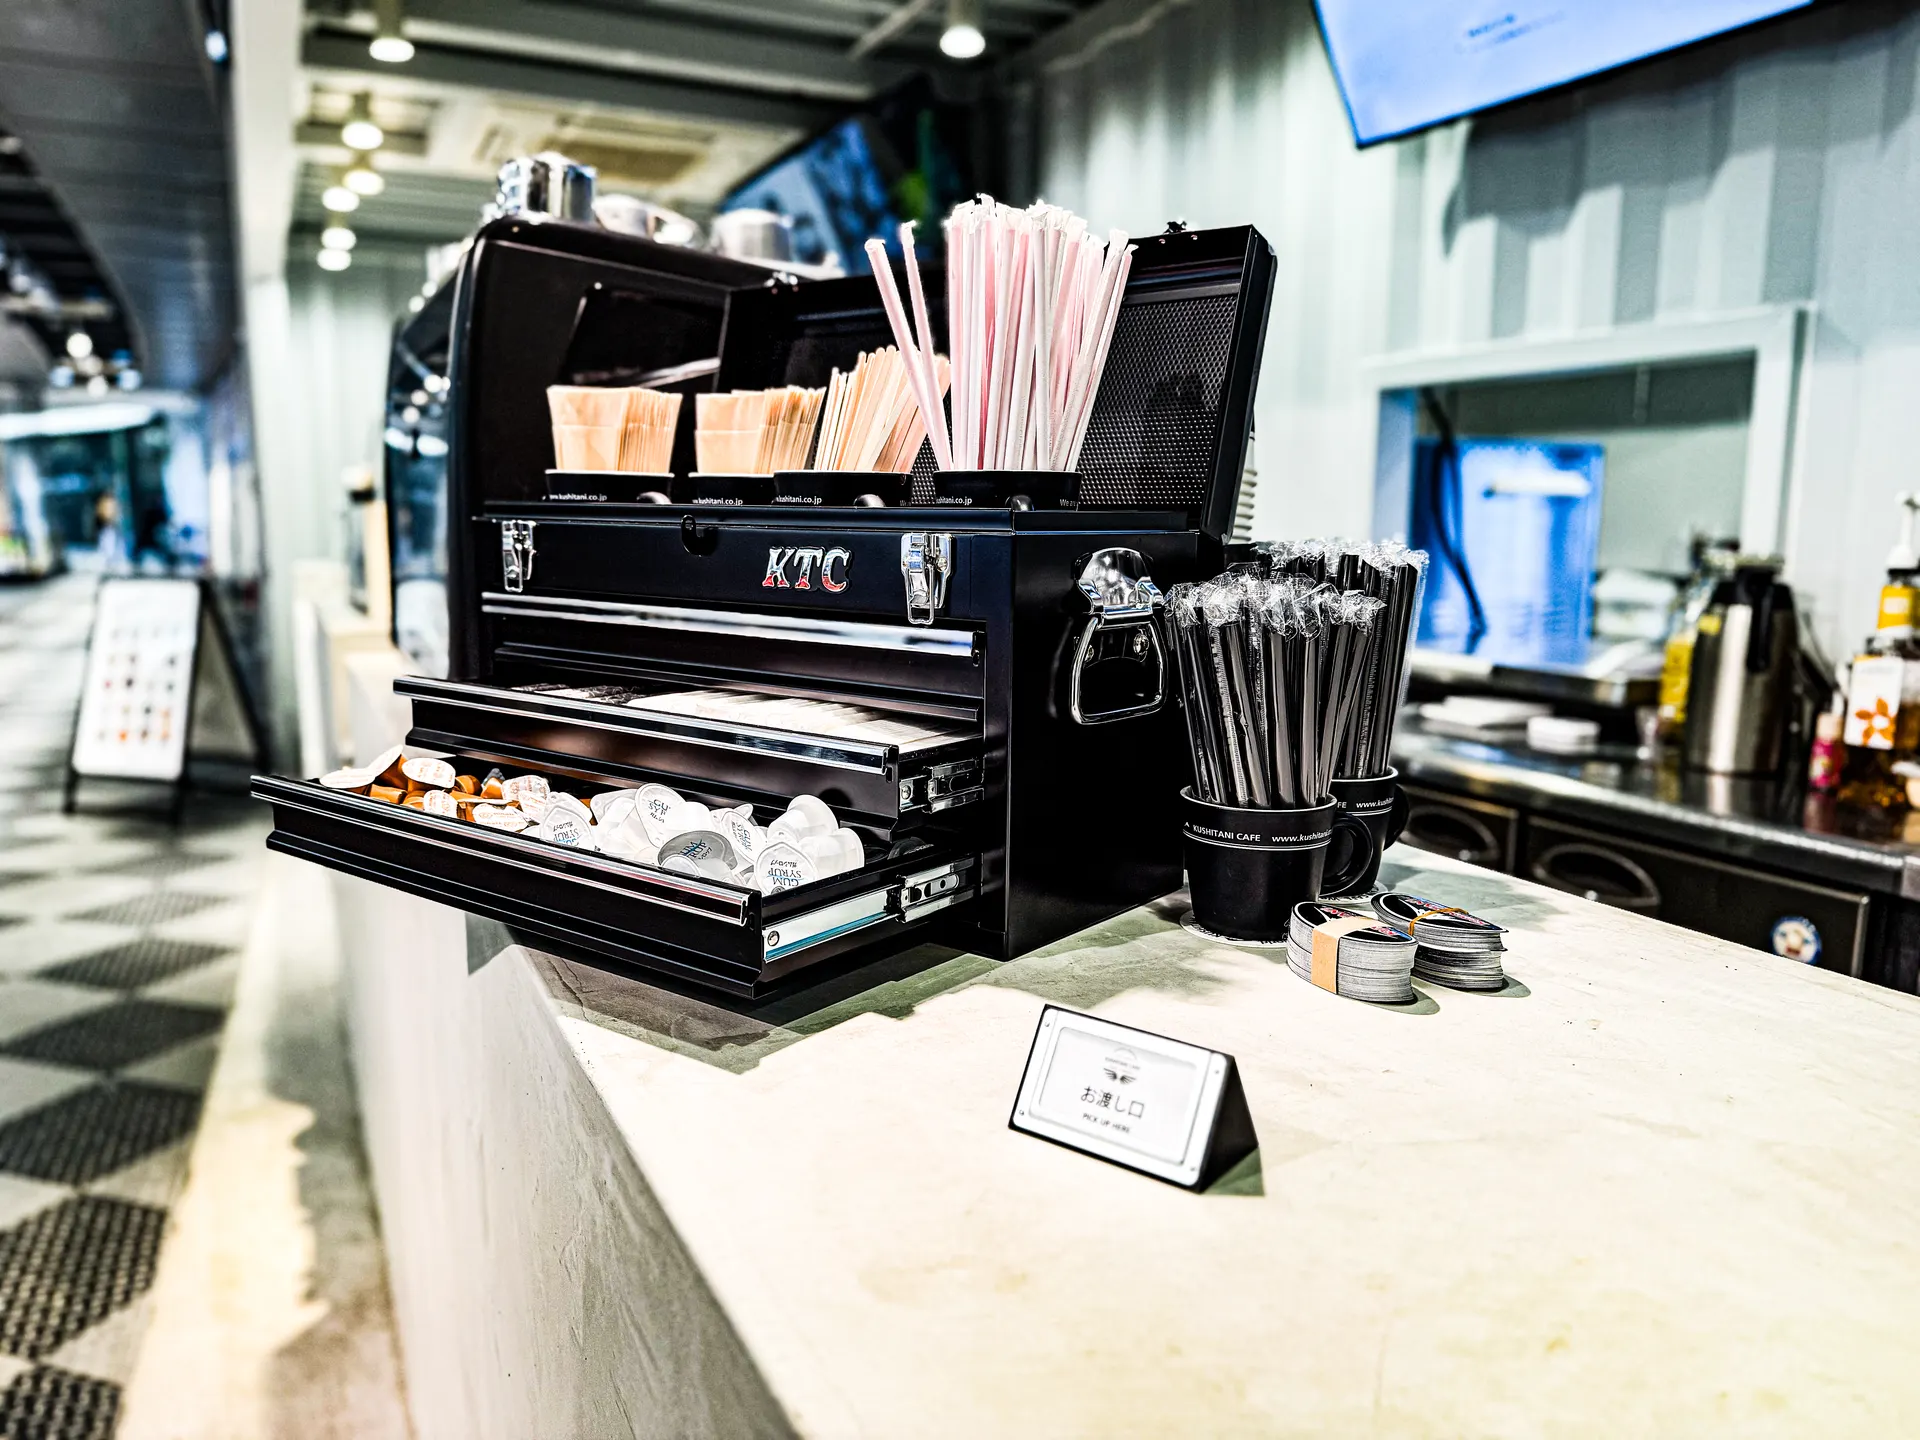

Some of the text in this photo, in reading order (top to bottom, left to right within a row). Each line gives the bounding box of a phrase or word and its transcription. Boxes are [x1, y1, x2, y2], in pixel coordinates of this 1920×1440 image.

[762, 546, 851, 593] KTC
[1192, 824, 1234, 840] KUSHITANI
[1236, 832, 1261, 842] CAFE
[767, 867, 802, 879] SYRUP
[771, 876, 800, 887] GUM
[1080, 1085, 1145, 1120] お渡し口
